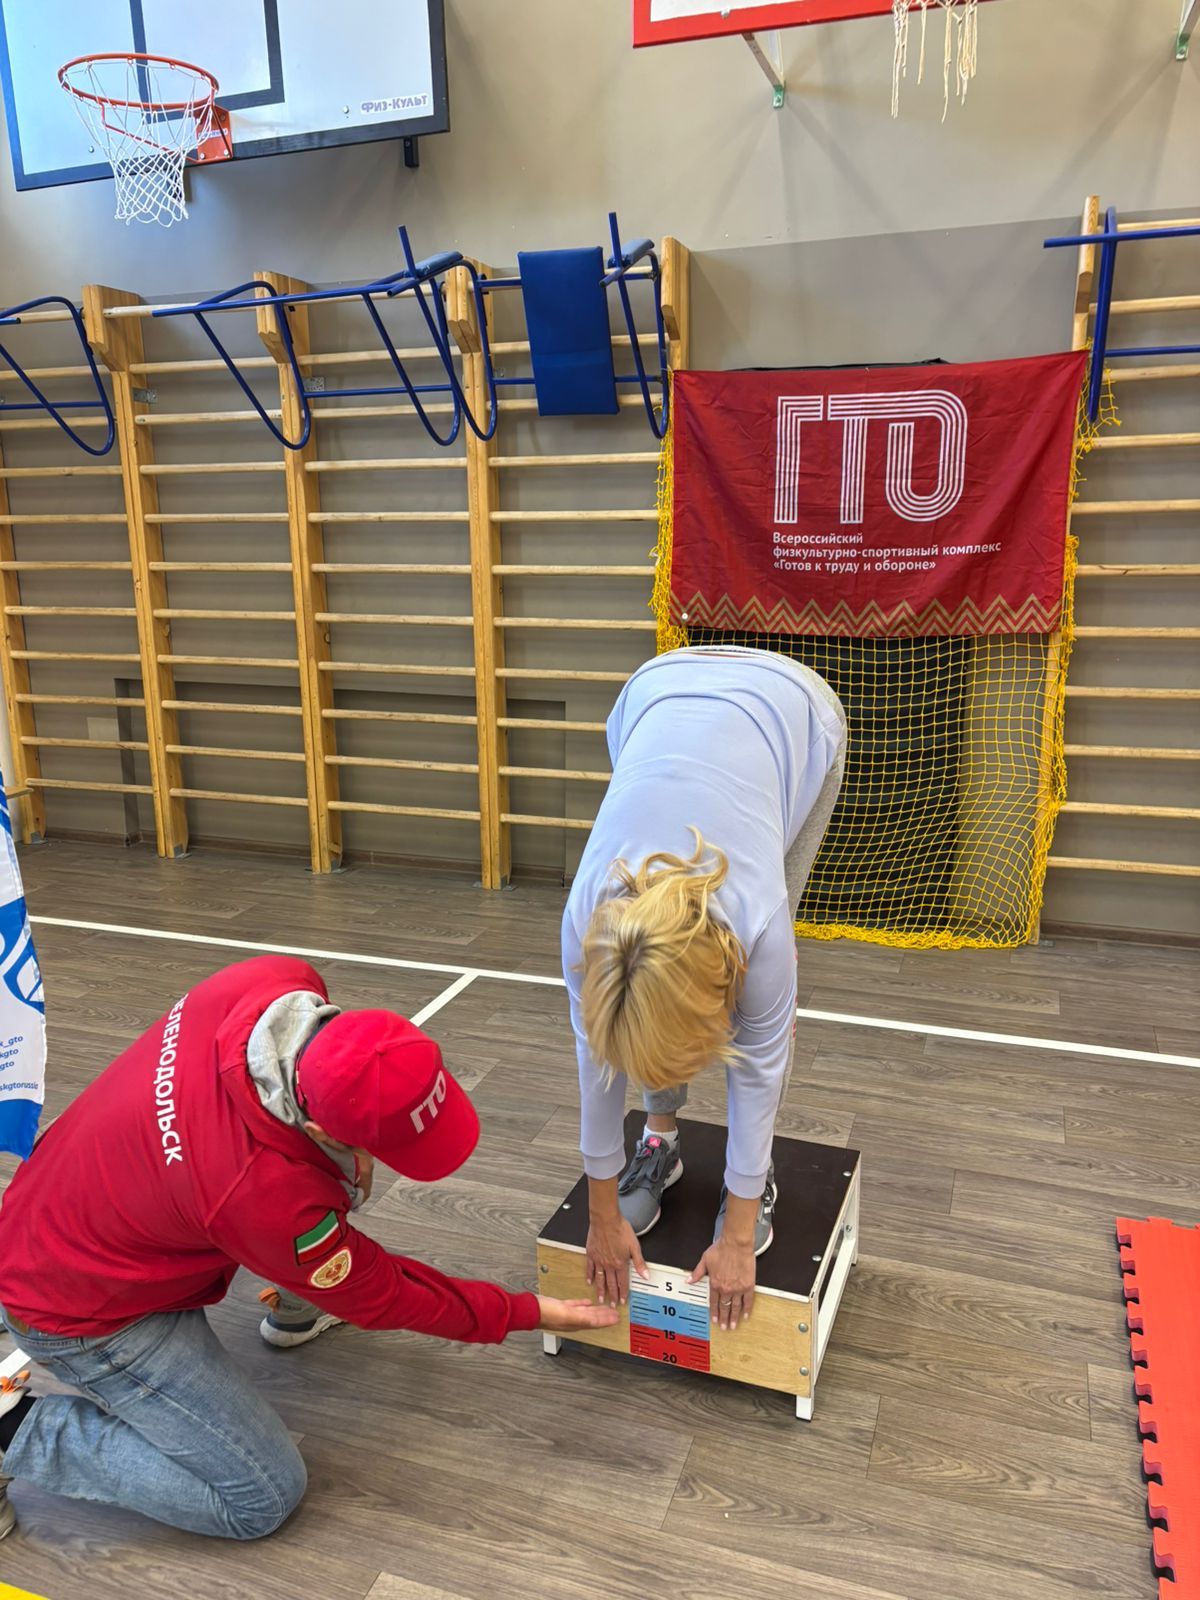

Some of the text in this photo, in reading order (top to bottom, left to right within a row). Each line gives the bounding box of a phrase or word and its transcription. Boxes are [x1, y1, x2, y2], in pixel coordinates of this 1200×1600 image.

[774, 389, 968, 524] ГТО
[773, 532, 863, 546] Всероссийский
[773, 541, 1002, 560] физкультурно-спортивный комплекс
[773, 559, 937, 573] «Готов к труду и обороне»
[665, 1281, 673, 1292] 5
[662, 1305, 677, 1317] 10
[663, 1329, 676, 1341] 15
[662, 1352, 678, 1364] 20
